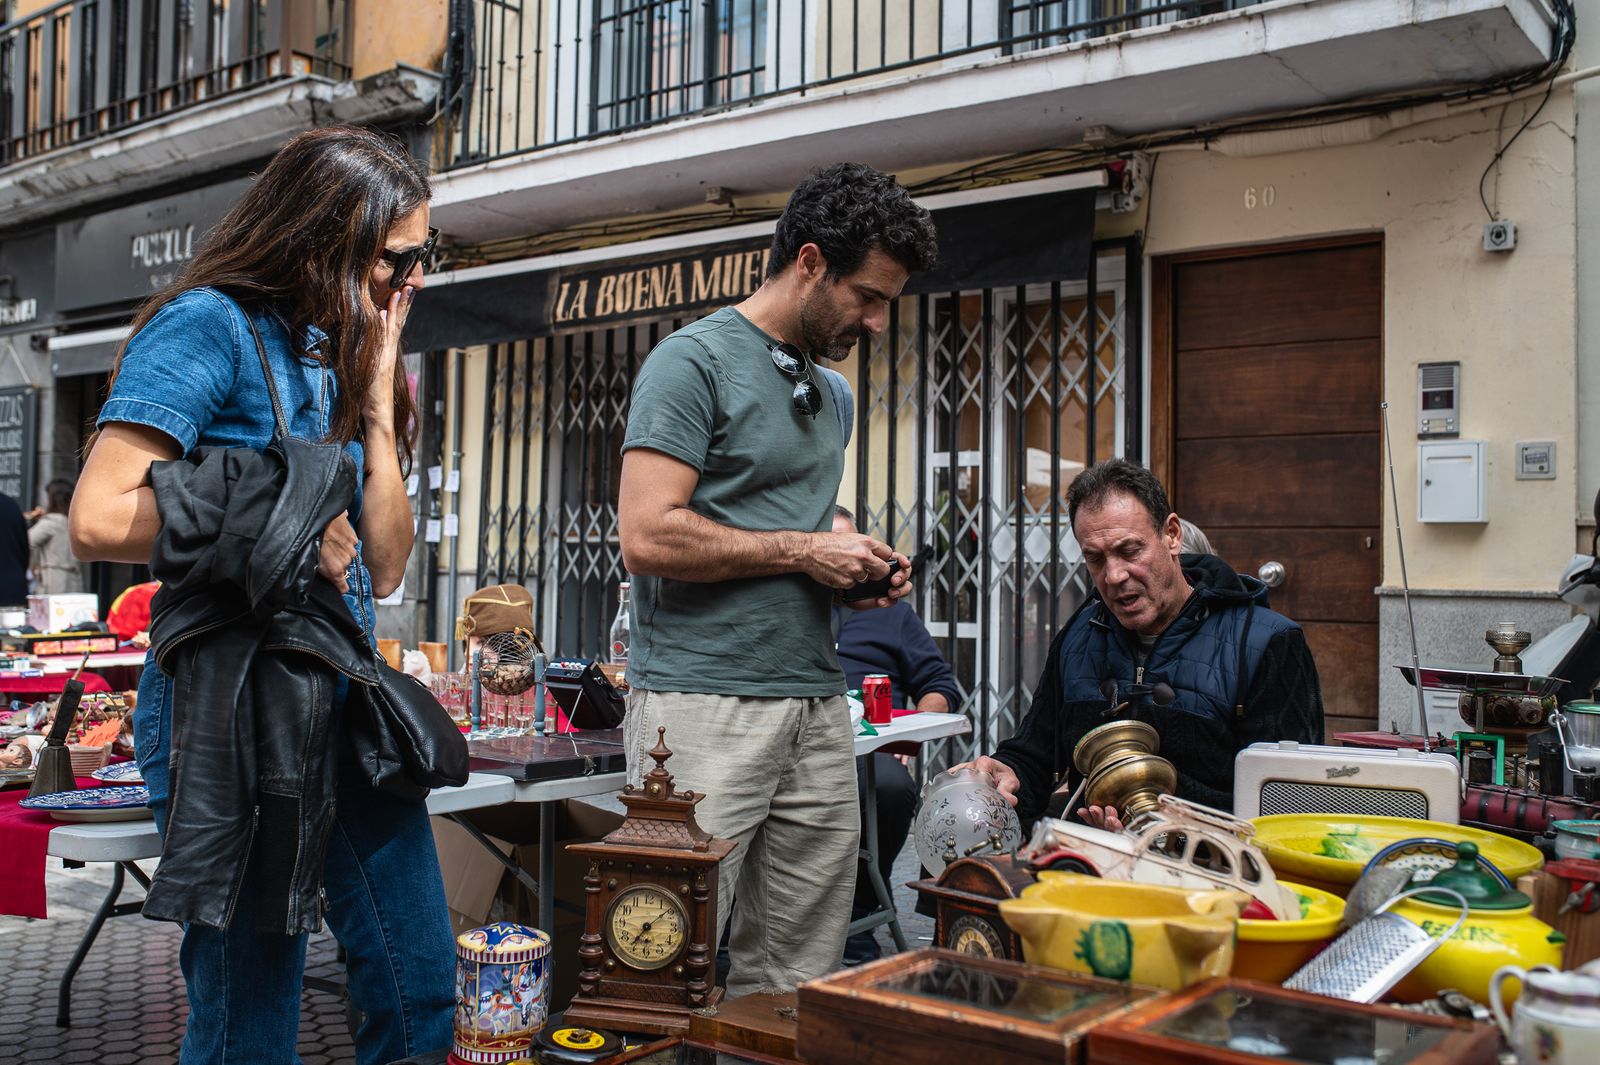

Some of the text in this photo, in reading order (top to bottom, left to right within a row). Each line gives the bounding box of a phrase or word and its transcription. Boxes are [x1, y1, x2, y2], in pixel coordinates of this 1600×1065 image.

[1244, 186, 1276, 209] 60
[555, 279, 589, 322] LA
[595, 262, 684, 317] BUENA
[623, 905, 632, 916] 10
